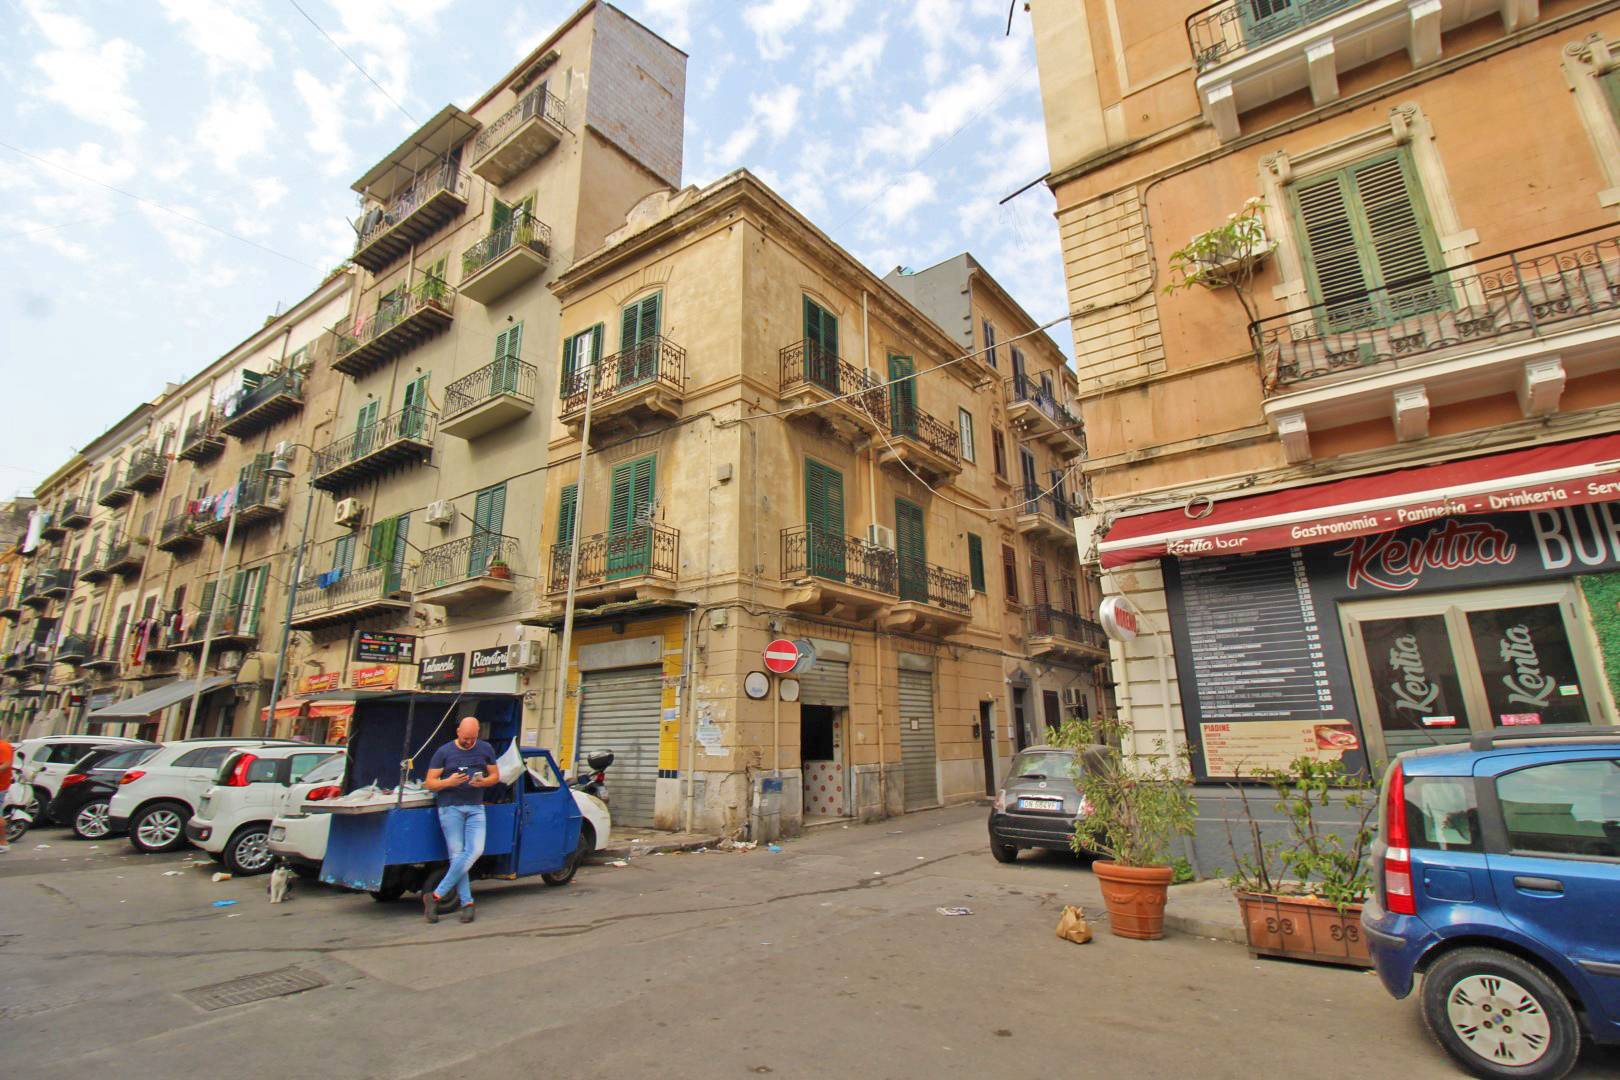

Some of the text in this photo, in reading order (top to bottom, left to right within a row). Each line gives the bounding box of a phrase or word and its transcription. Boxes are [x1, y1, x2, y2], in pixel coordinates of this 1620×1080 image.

[1291, 515, 1378, 539] Gastronomia
[1488, 487, 1568, 509] Drinkeria
[1167, 537, 1248, 556] Kentia bar
[1334, 520, 1516, 591] Kentia
[422, 656, 455, 674] Tabacchi
[1390, 633, 1440, 713] Kentia
[1500, 624, 1556, 707] Kentia
[1204, 724, 1230, 732] PIADINE
